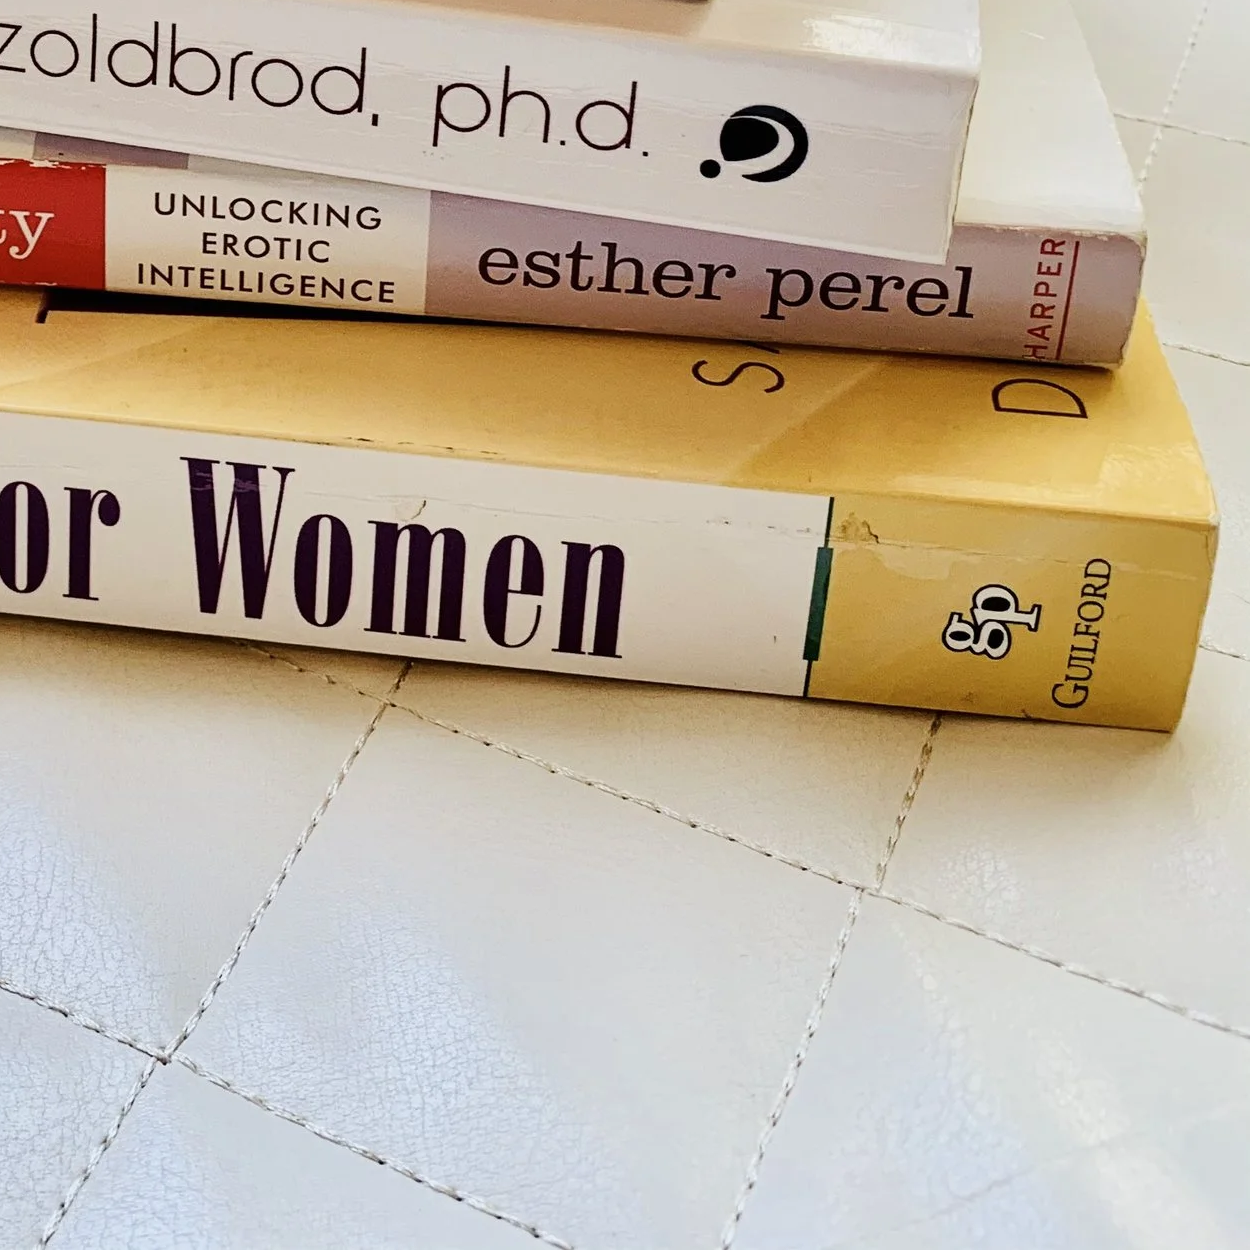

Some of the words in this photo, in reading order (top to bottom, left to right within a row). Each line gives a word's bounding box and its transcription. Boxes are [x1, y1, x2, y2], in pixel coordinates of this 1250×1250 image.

[432, 65, 650, 158] ph.d.
[154, 192, 382, 230] UNLOCKING
[202, 232, 330, 263] EROTIC
[138, 263, 395, 303] INTELLIGENCE
[477, 241, 736, 301] esther
[760, 264, 975, 321] perel
[1022, 238, 1066, 360] HARPER
[179, 456, 627, 659] Women
